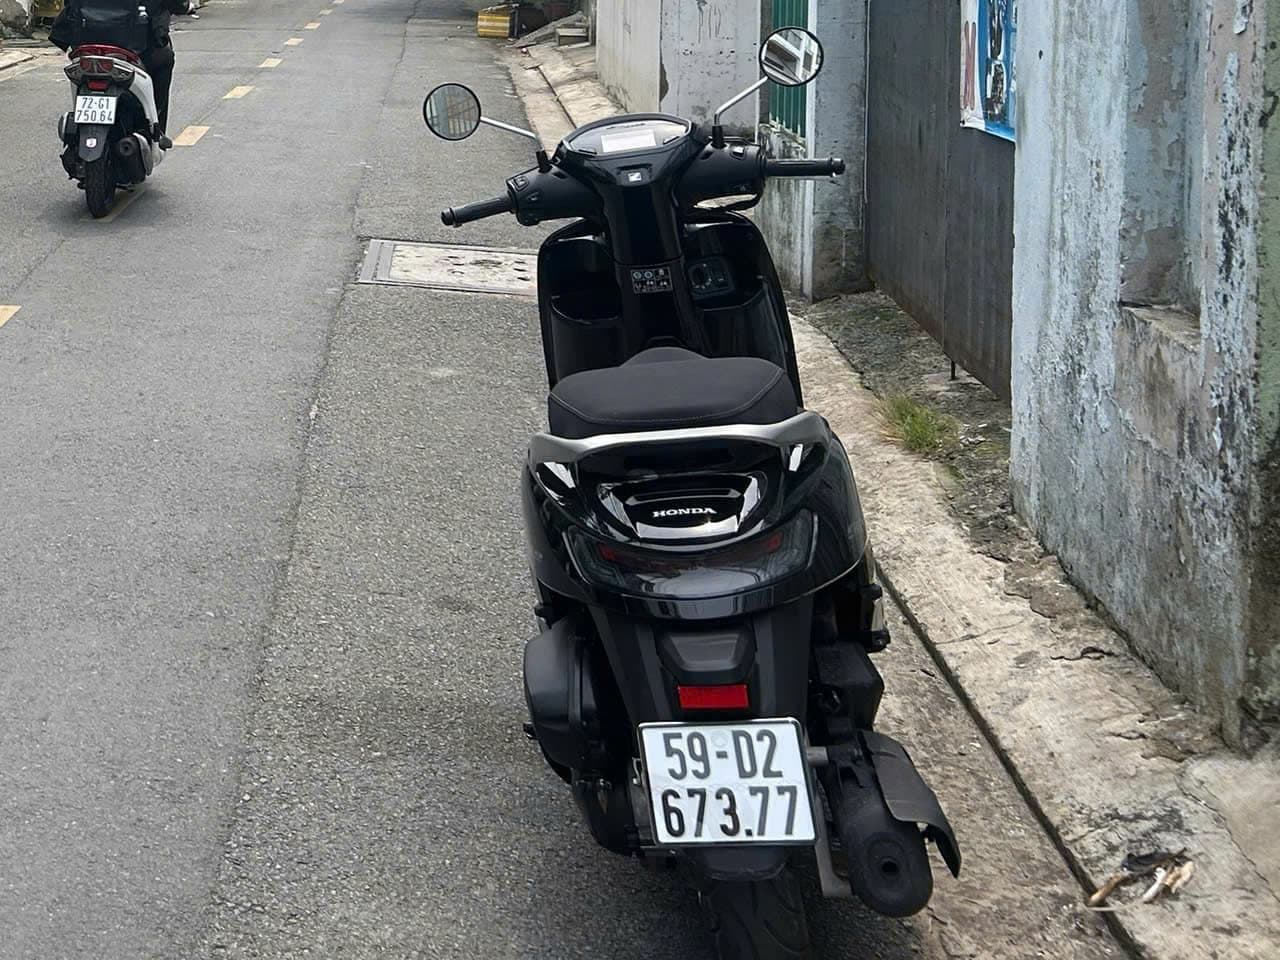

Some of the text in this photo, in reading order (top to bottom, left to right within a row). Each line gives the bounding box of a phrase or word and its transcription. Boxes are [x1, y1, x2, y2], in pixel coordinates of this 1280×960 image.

[652, 507, 718, 518] HONDA
[662, 729, 783, 780] 59-D2
[661, 785, 798, 838] 673.77
